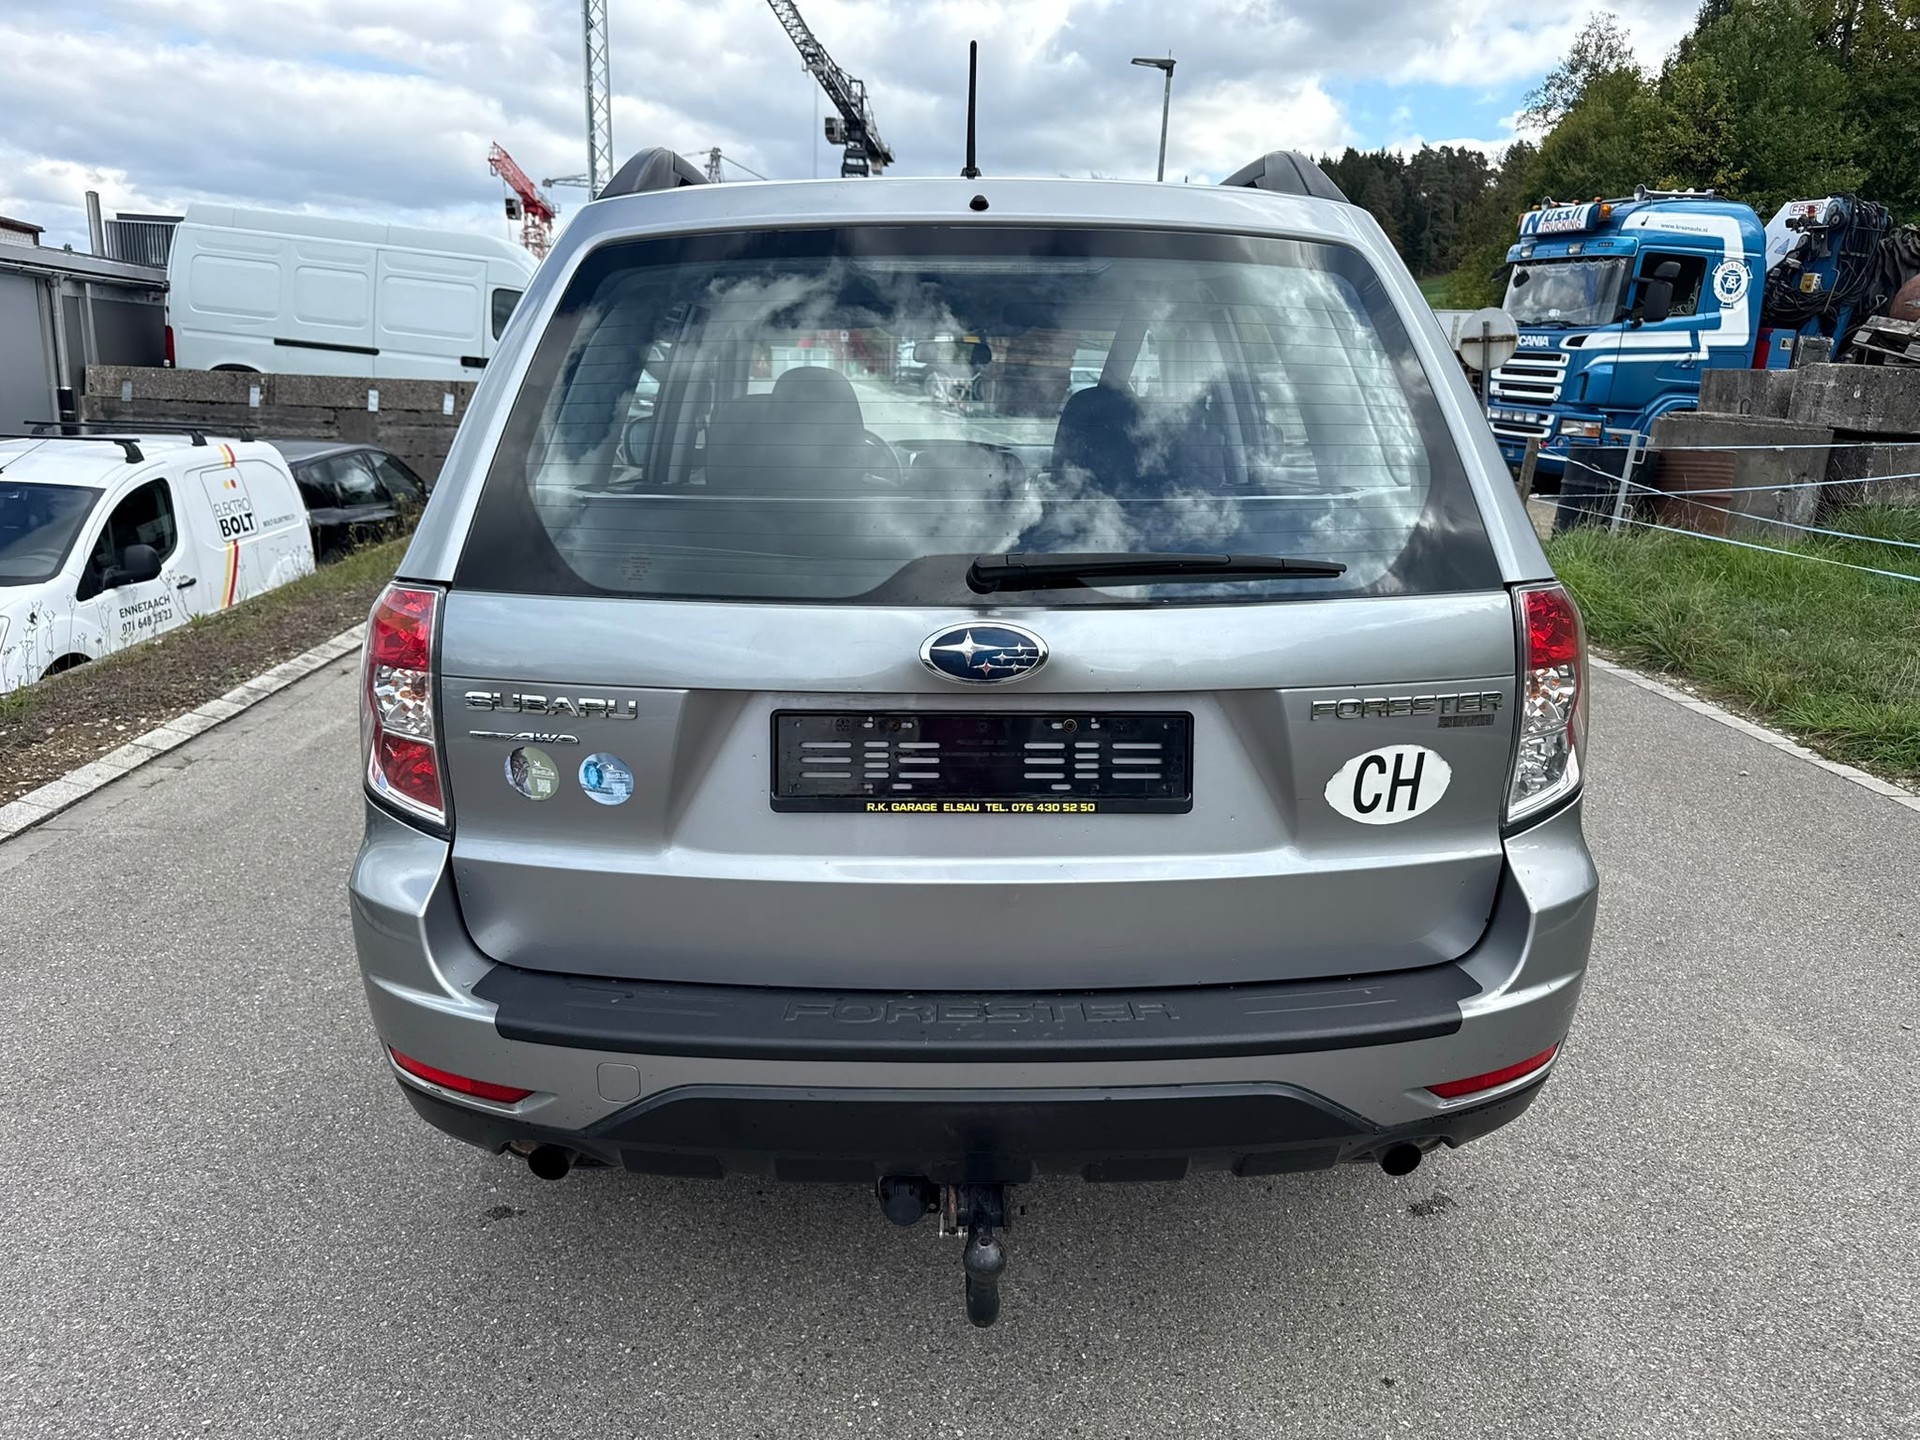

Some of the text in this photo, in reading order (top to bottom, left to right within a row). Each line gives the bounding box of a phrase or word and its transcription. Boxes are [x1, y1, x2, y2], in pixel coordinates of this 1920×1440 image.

[1541, 219, 1582, 232] TRUCKING
[1517, 334, 1550, 347] CANIA
[219, 512, 255, 538] BOLT
[119, 594, 171, 619] ENNETAACH
[137, 615, 152, 629] 648
[464, 691, 638, 720] SUBARU
[1310, 690, 1504, 721] FORESTER
[508, 732, 580, 744] AWD
[1352, 751, 1426, 814] CH
[866, 802, 1096, 812] R.K. GARAGE ELSAU TEL. 076 430 52 50
[782, 999, 1181, 1025] FORESTER
